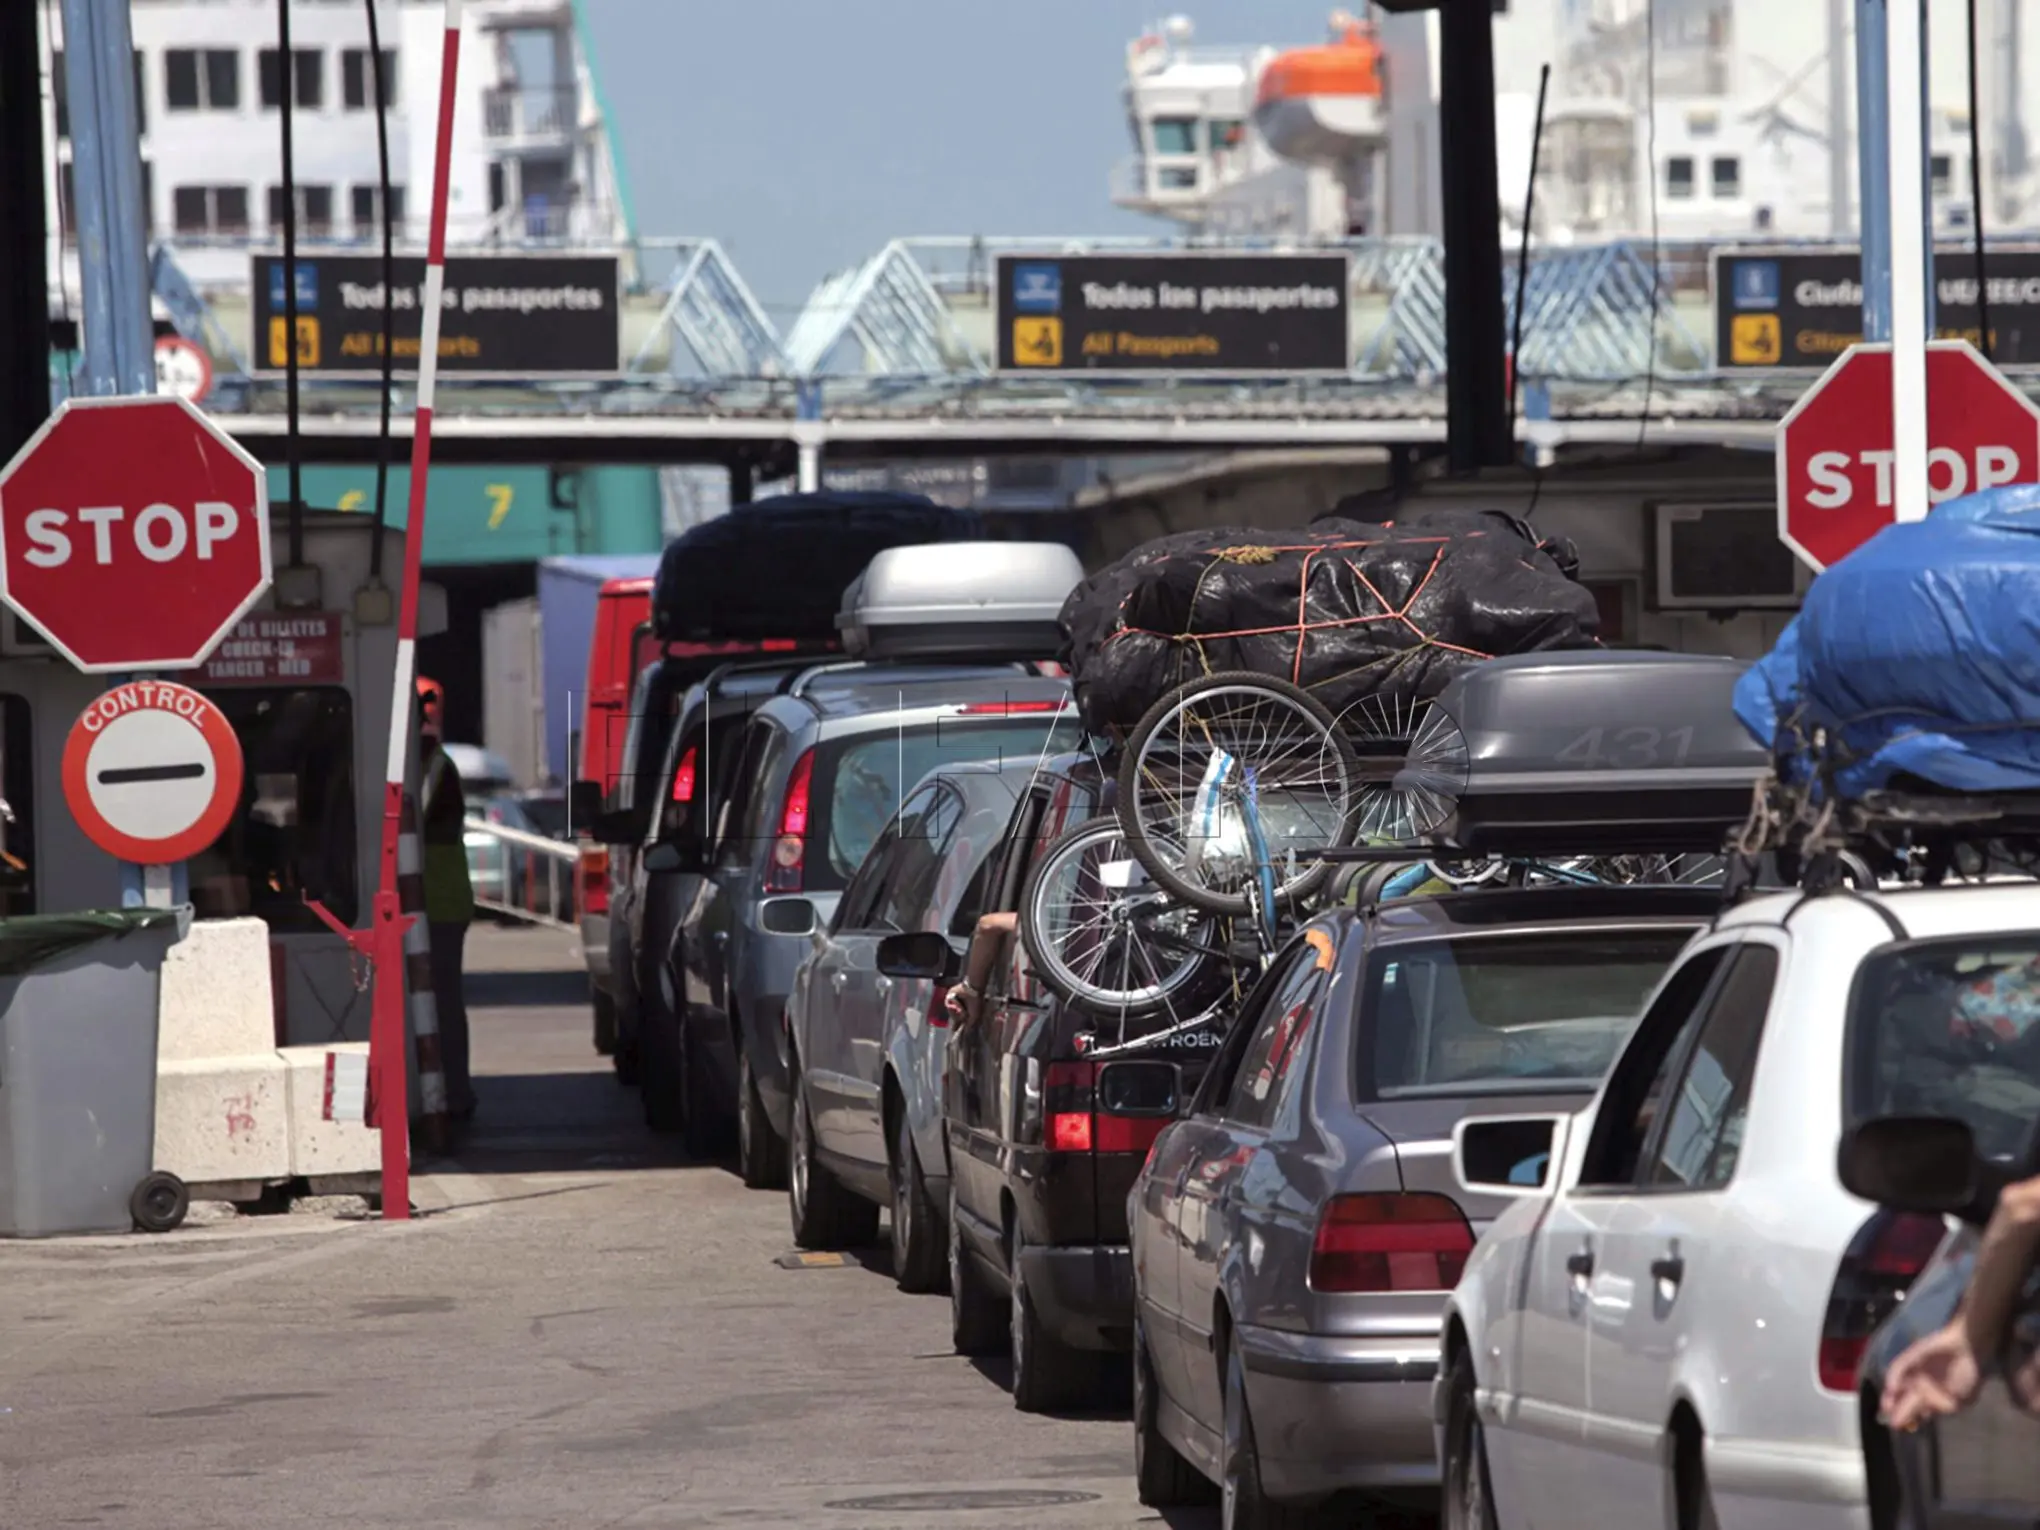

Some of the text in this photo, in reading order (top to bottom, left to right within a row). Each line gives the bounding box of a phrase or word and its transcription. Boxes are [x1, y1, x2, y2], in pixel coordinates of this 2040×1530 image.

[338, 281, 603, 315] Todos ls pasaportes
[1082, 281, 1338, 313] Todos los pasaportes
[1795, 278, 1863, 306] Ciuda
[340, 332, 480, 357] All Passorts
[1082, 331, 1219, 359] All Passports
[1804, 445, 2021, 509] STOP
[484, 483, 514, 531] 7
[23, 501, 240, 568] STOP
[261, 620, 327, 637] BILLETES
[82, 684, 208, 733] CONTROL
[1553, 725, 1694, 768] 431
[1142, 1029, 1223, 1048] ROËN
